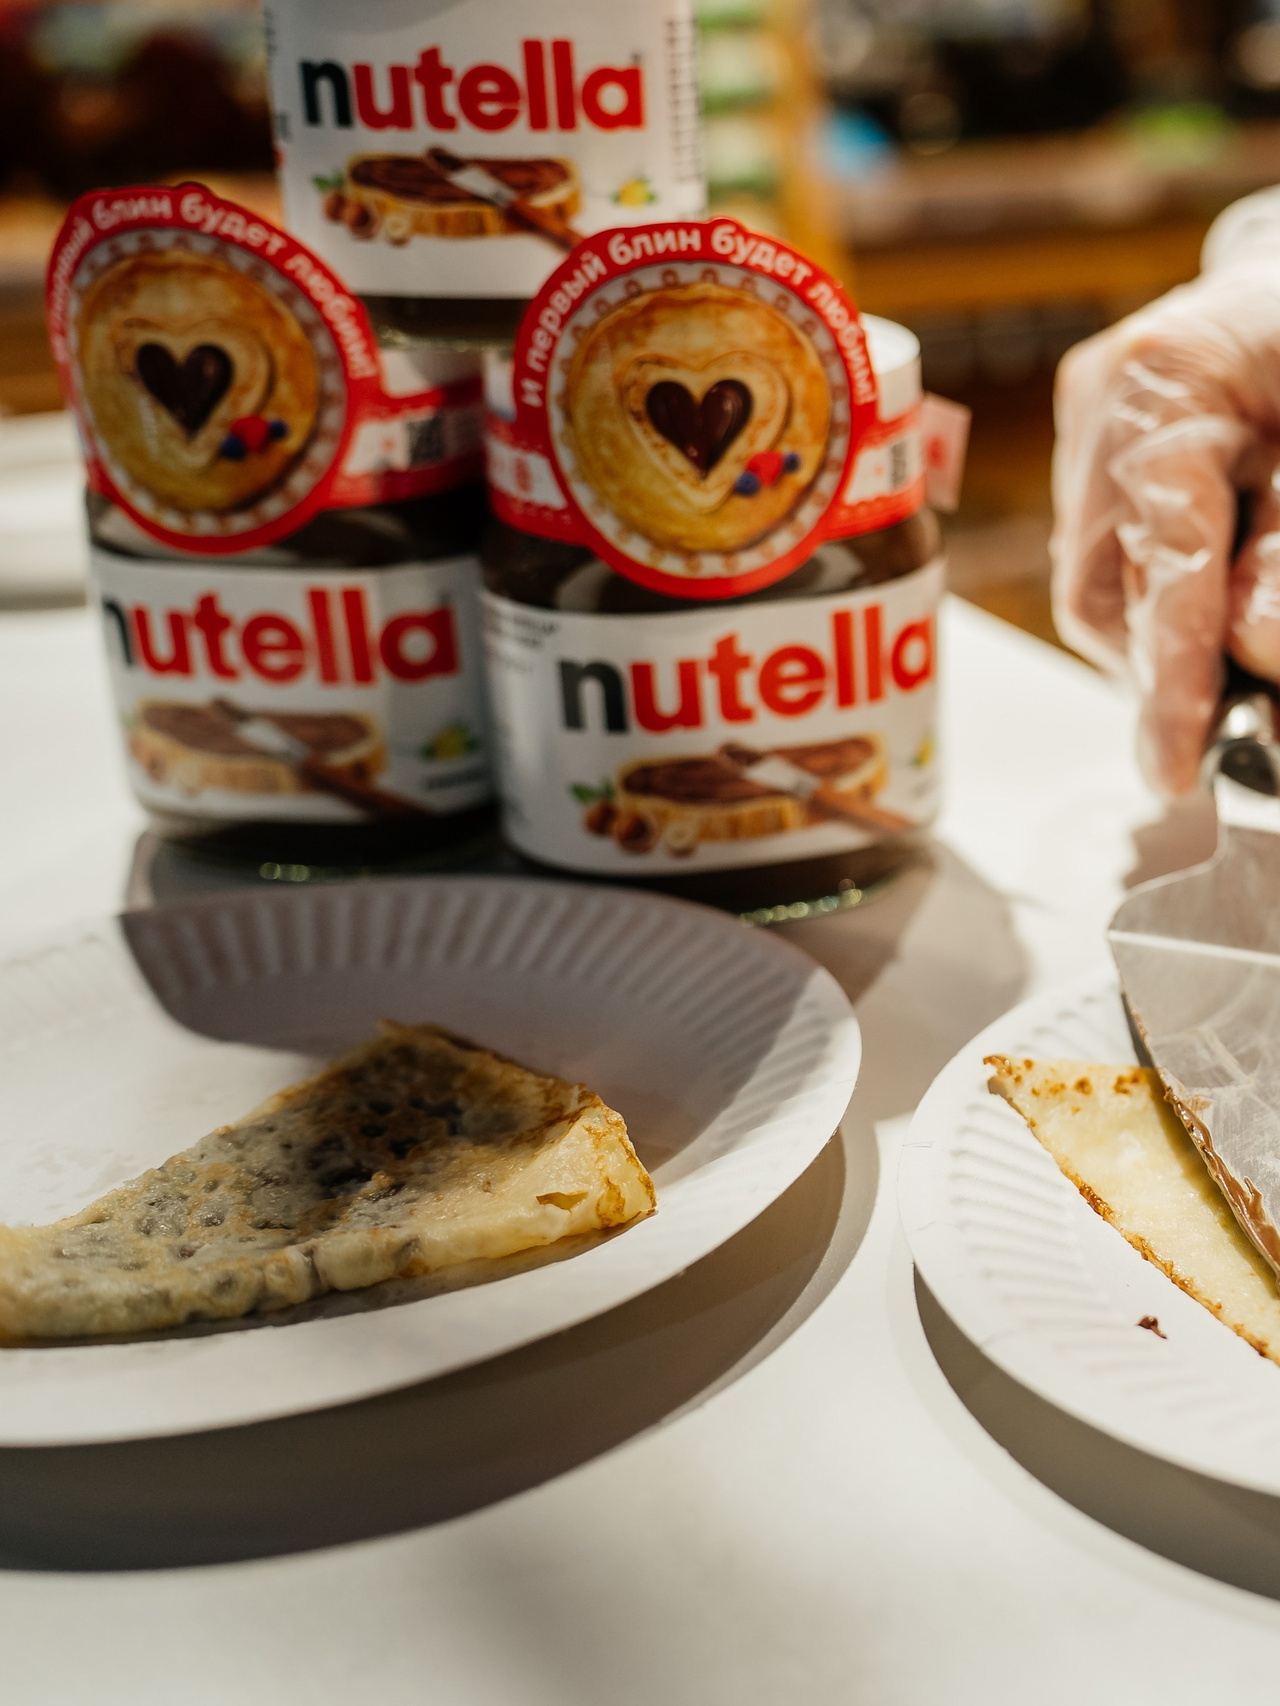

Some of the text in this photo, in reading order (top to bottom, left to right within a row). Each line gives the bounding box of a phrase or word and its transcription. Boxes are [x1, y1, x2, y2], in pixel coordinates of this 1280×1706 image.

[299, 39, 645, 132] nutella
[92, 195, 174, 231] блин
[179, 192, 288, 256] будет
[526, 250, 608, 373] первый
[607, 229, 702, 266] блин
[711, 224, 813, 286] будет
[806, 281, 879, 406] любим!
[558, 604, 937, 733] nutella
